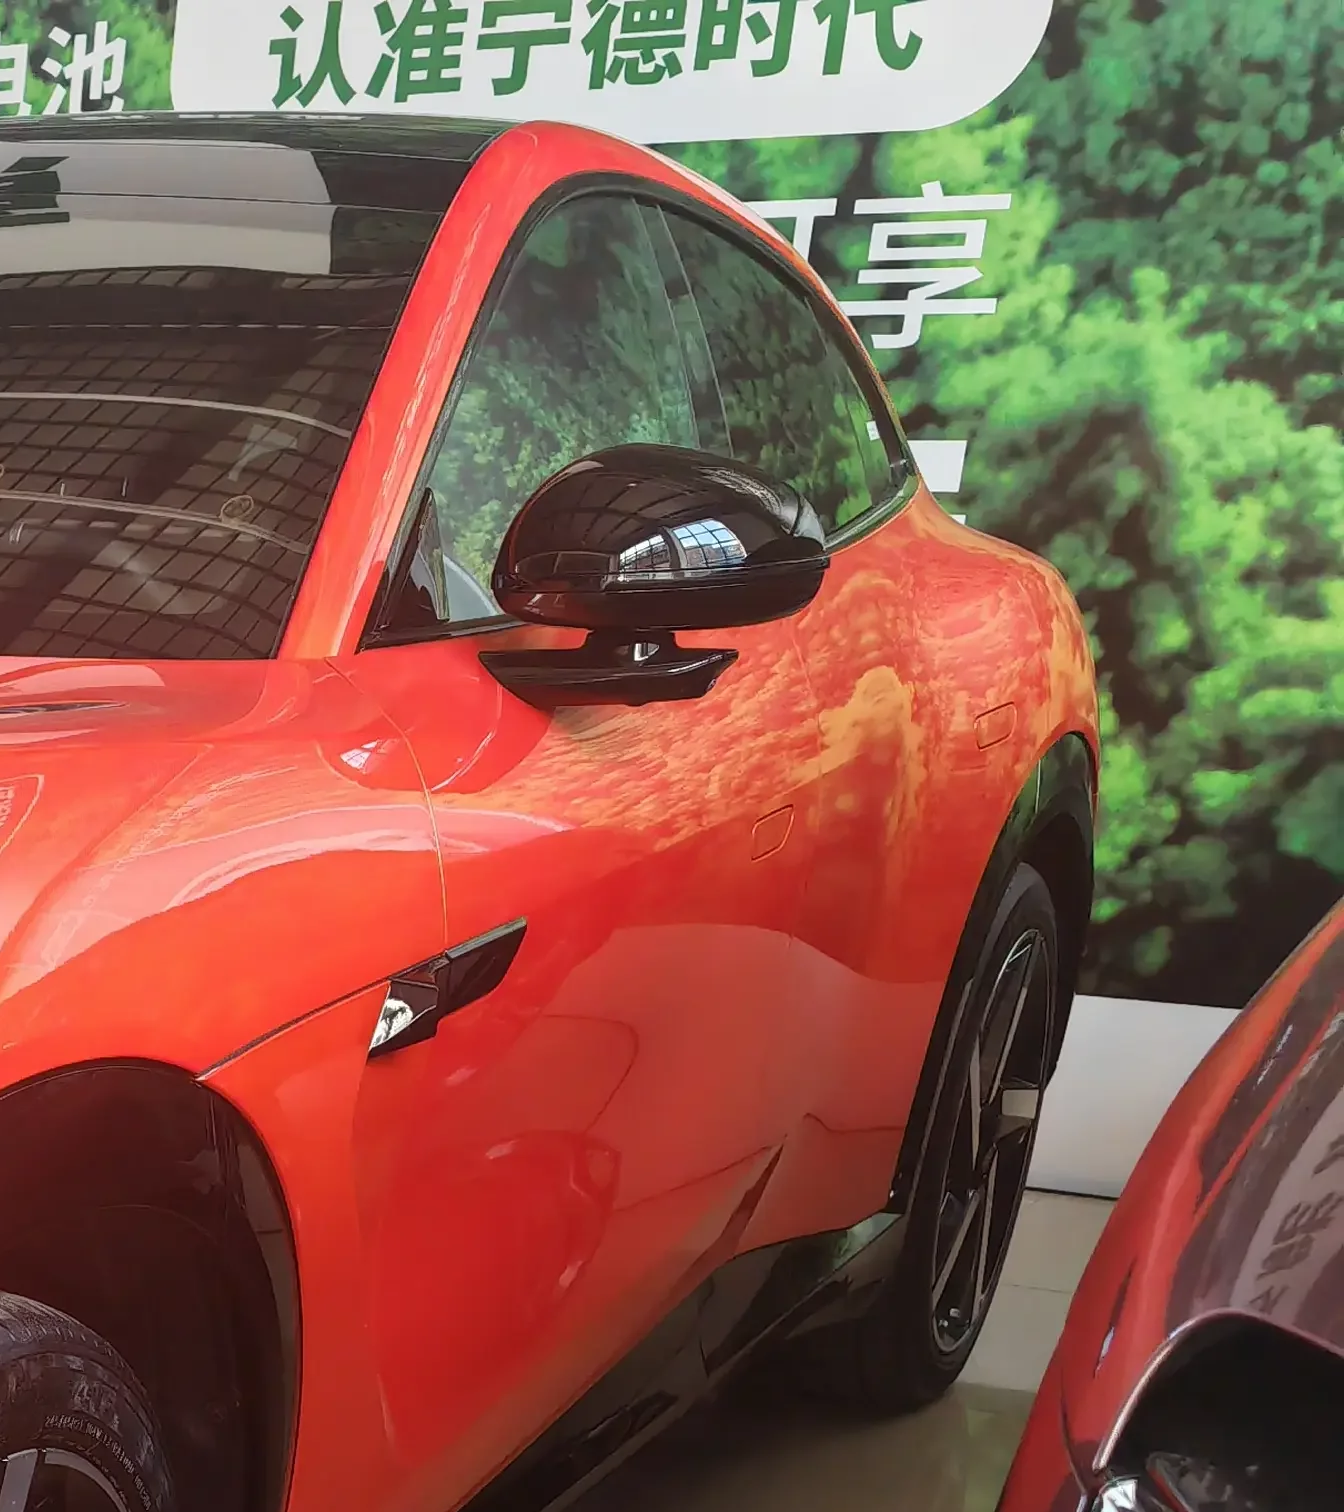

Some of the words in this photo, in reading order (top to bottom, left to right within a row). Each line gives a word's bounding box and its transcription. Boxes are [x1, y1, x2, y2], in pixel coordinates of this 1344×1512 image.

[268, 0, 924, 109] 认准宁德时代
